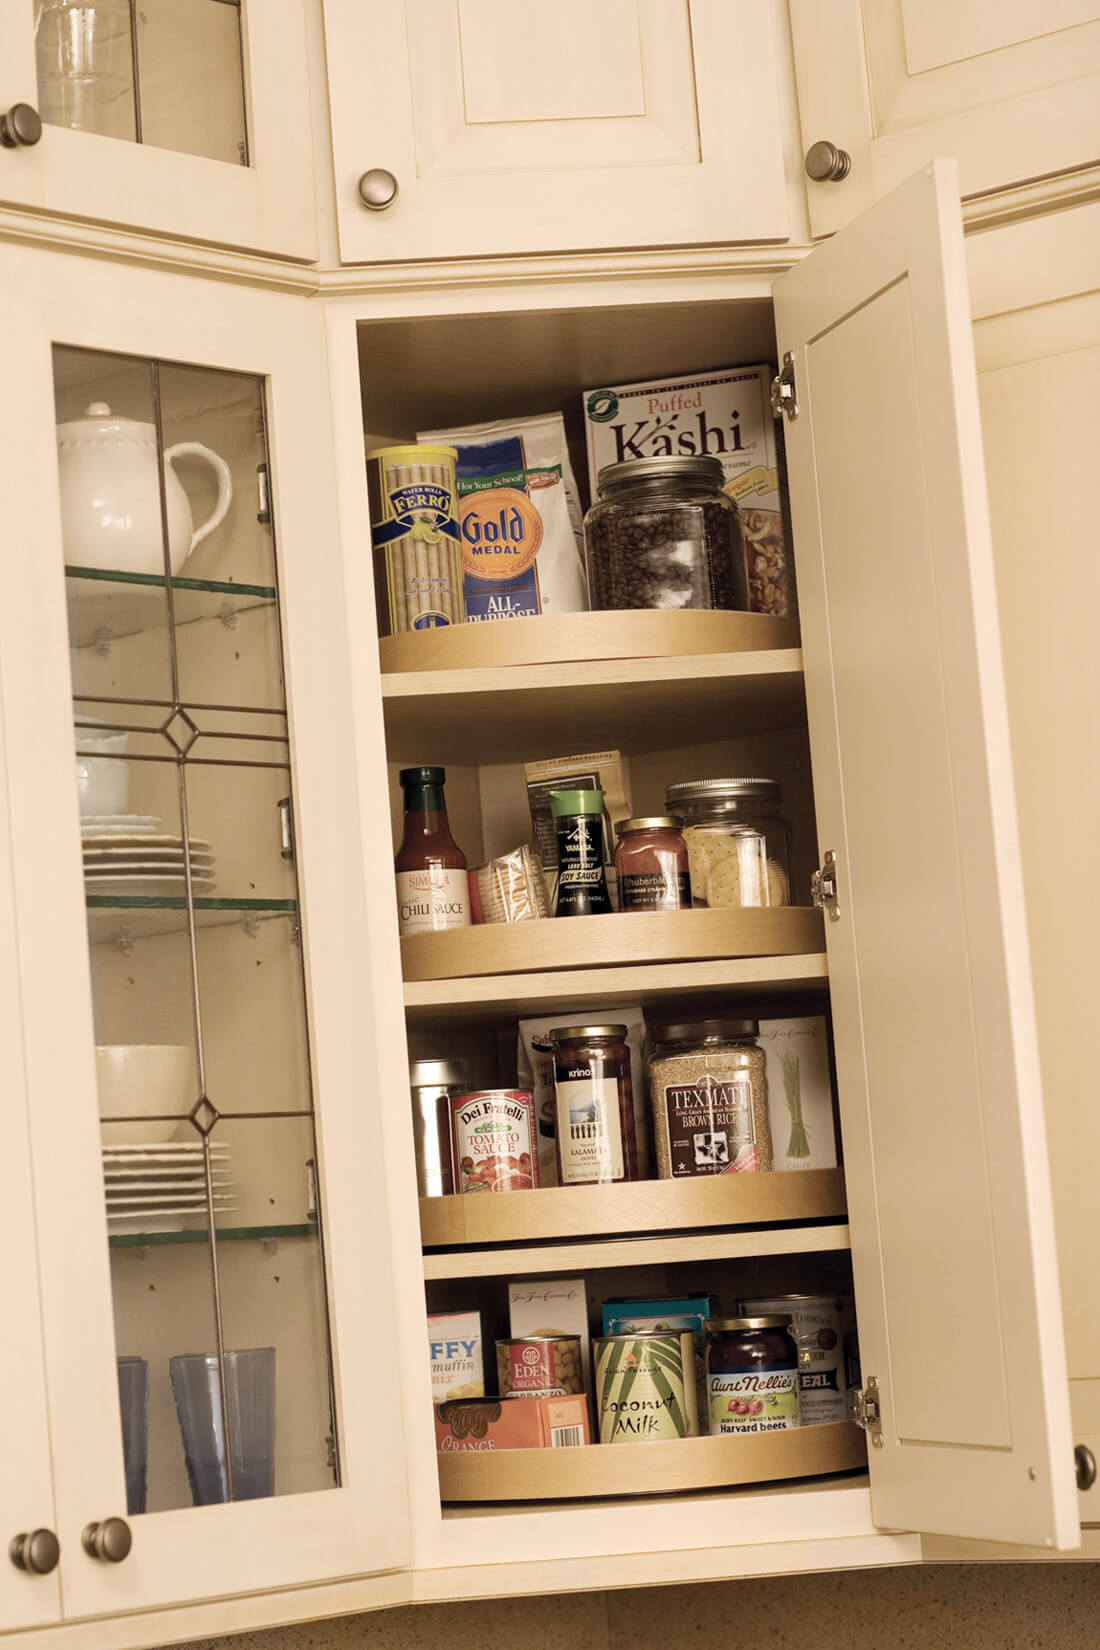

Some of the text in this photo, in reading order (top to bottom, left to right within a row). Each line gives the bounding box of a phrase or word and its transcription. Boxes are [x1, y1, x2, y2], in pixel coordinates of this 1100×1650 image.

[648, 392, 703, 414] Puffed
[609, 409, 745, 462] Kashi
[393, 493, 450, 514] FERRO
[462, 506, 525, 545] Gold
[472, 545, 521, 555] MEDAL
[487, 595, 521, 613] ALL-
[561, 871, 599, 882] SOY SAUCE
[401, 902, 464, 921] CHILI SAUCE
[461, 1102, 524, 1125] Dei Fratelli
[467, 1133, 520, 1146] TOMATO
[473, 1143, 516, 1154] SAUCE
[432, 1359, 474, 1373] muffin
[513, 1363, 550, 1379] EDEN
[512, 1377, 554, 1389] ORGANIC
[711, 1375, 793, 1393] Aunt Nellie's
[602, 1391, 676, 1412] Coconut
[615, 1414, 662, 1435] Milk
[720, 1421, 787, 1434] Harvard beets
